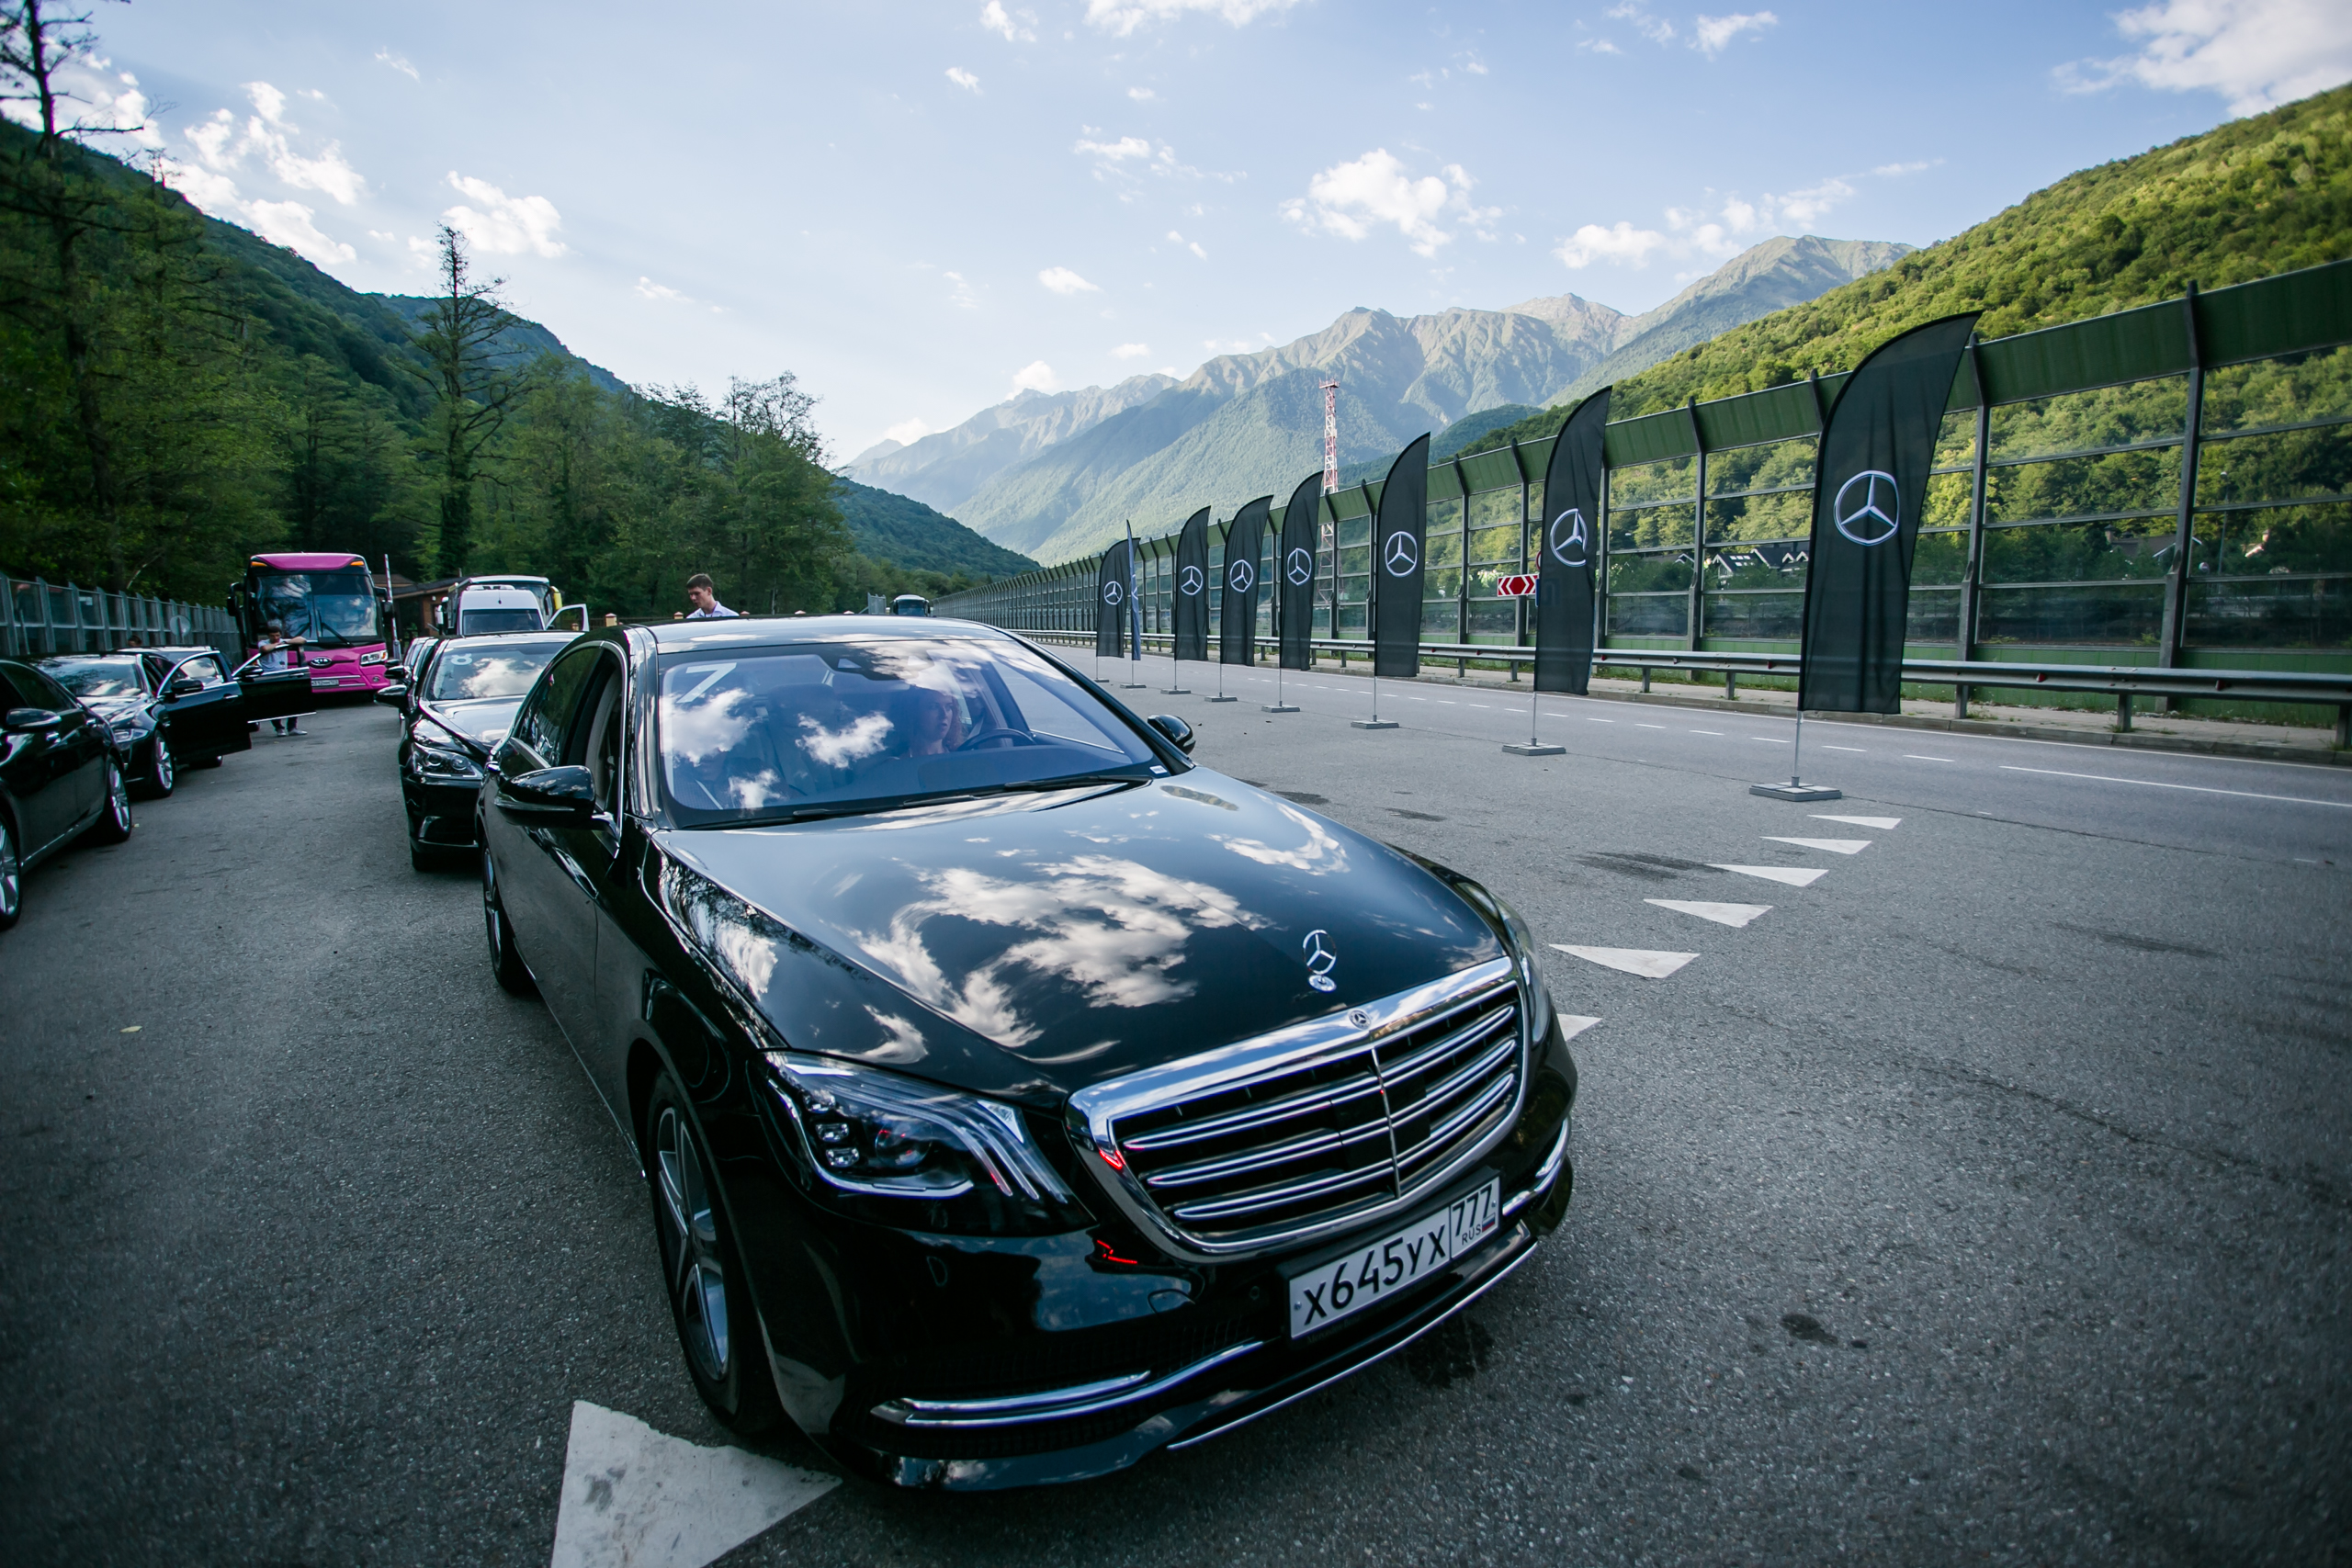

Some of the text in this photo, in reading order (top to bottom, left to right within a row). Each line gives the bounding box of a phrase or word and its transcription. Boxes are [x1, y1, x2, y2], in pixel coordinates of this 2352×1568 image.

[676, 662, 738, 704] 7
[1452, 1183, 1493, 1238] 777
[1461, 1224, 1482, 1247] RUS
